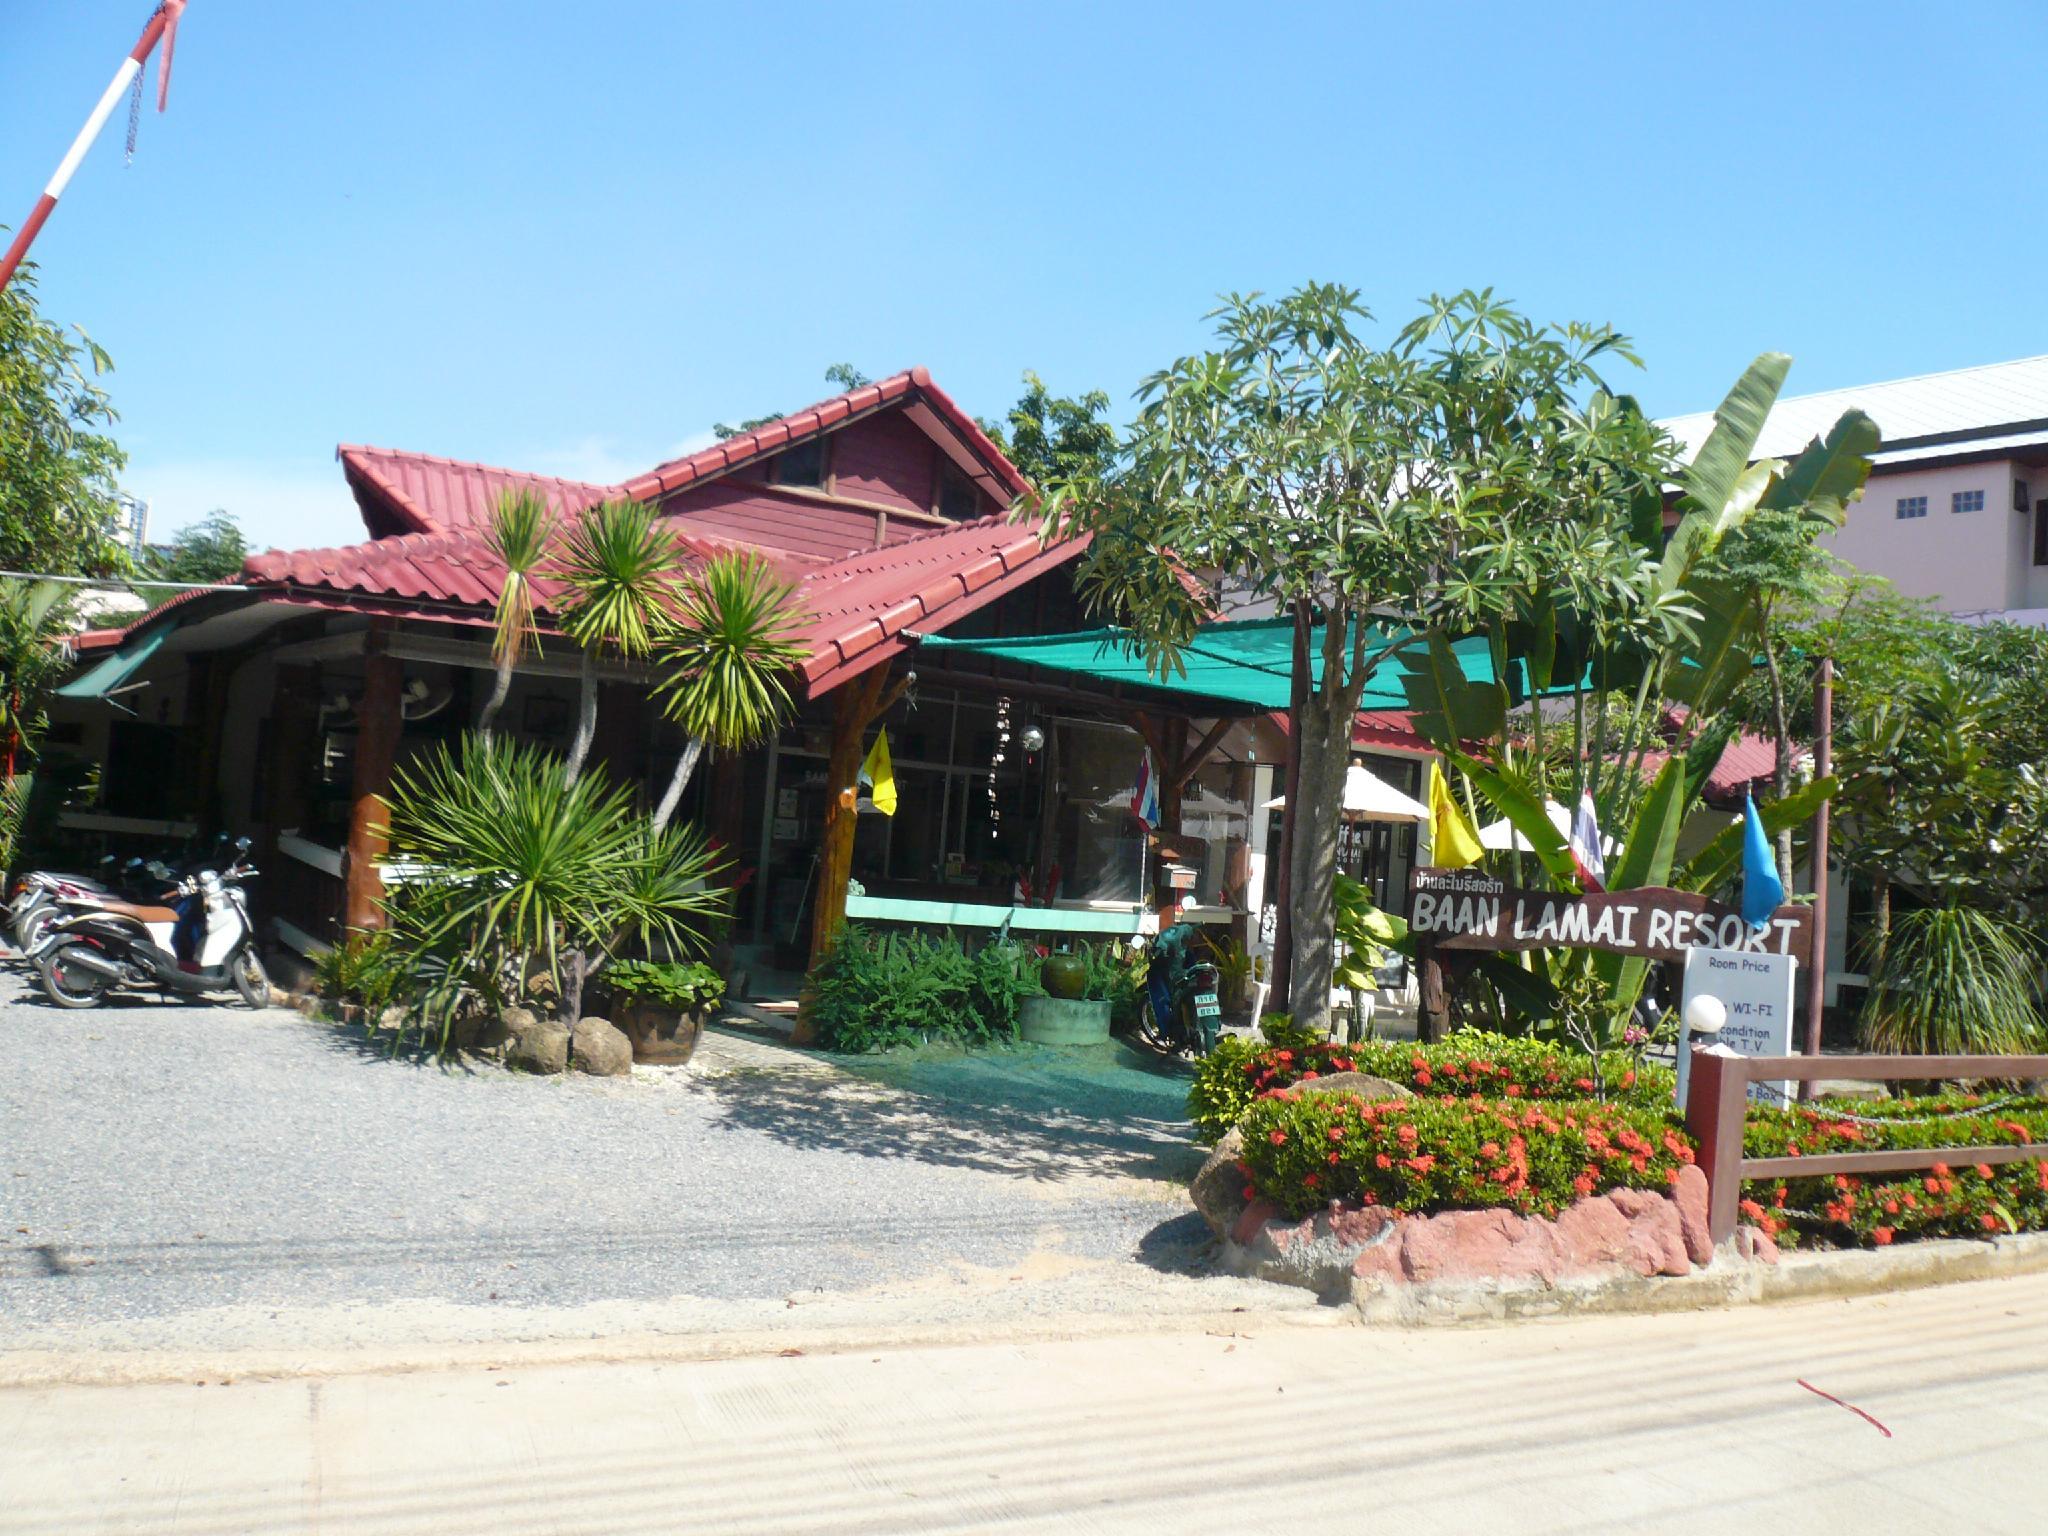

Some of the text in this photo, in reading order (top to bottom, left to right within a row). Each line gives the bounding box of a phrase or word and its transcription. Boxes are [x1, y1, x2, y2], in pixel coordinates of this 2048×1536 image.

[1412, 892, 1801, 956] BAAN LAMAI RESORT
[1709, 956, 1770, 973] Room Price
[1733, 1002, 1773, 1016] WI-FI
[1720, 1025, 1770, 1040] condition
